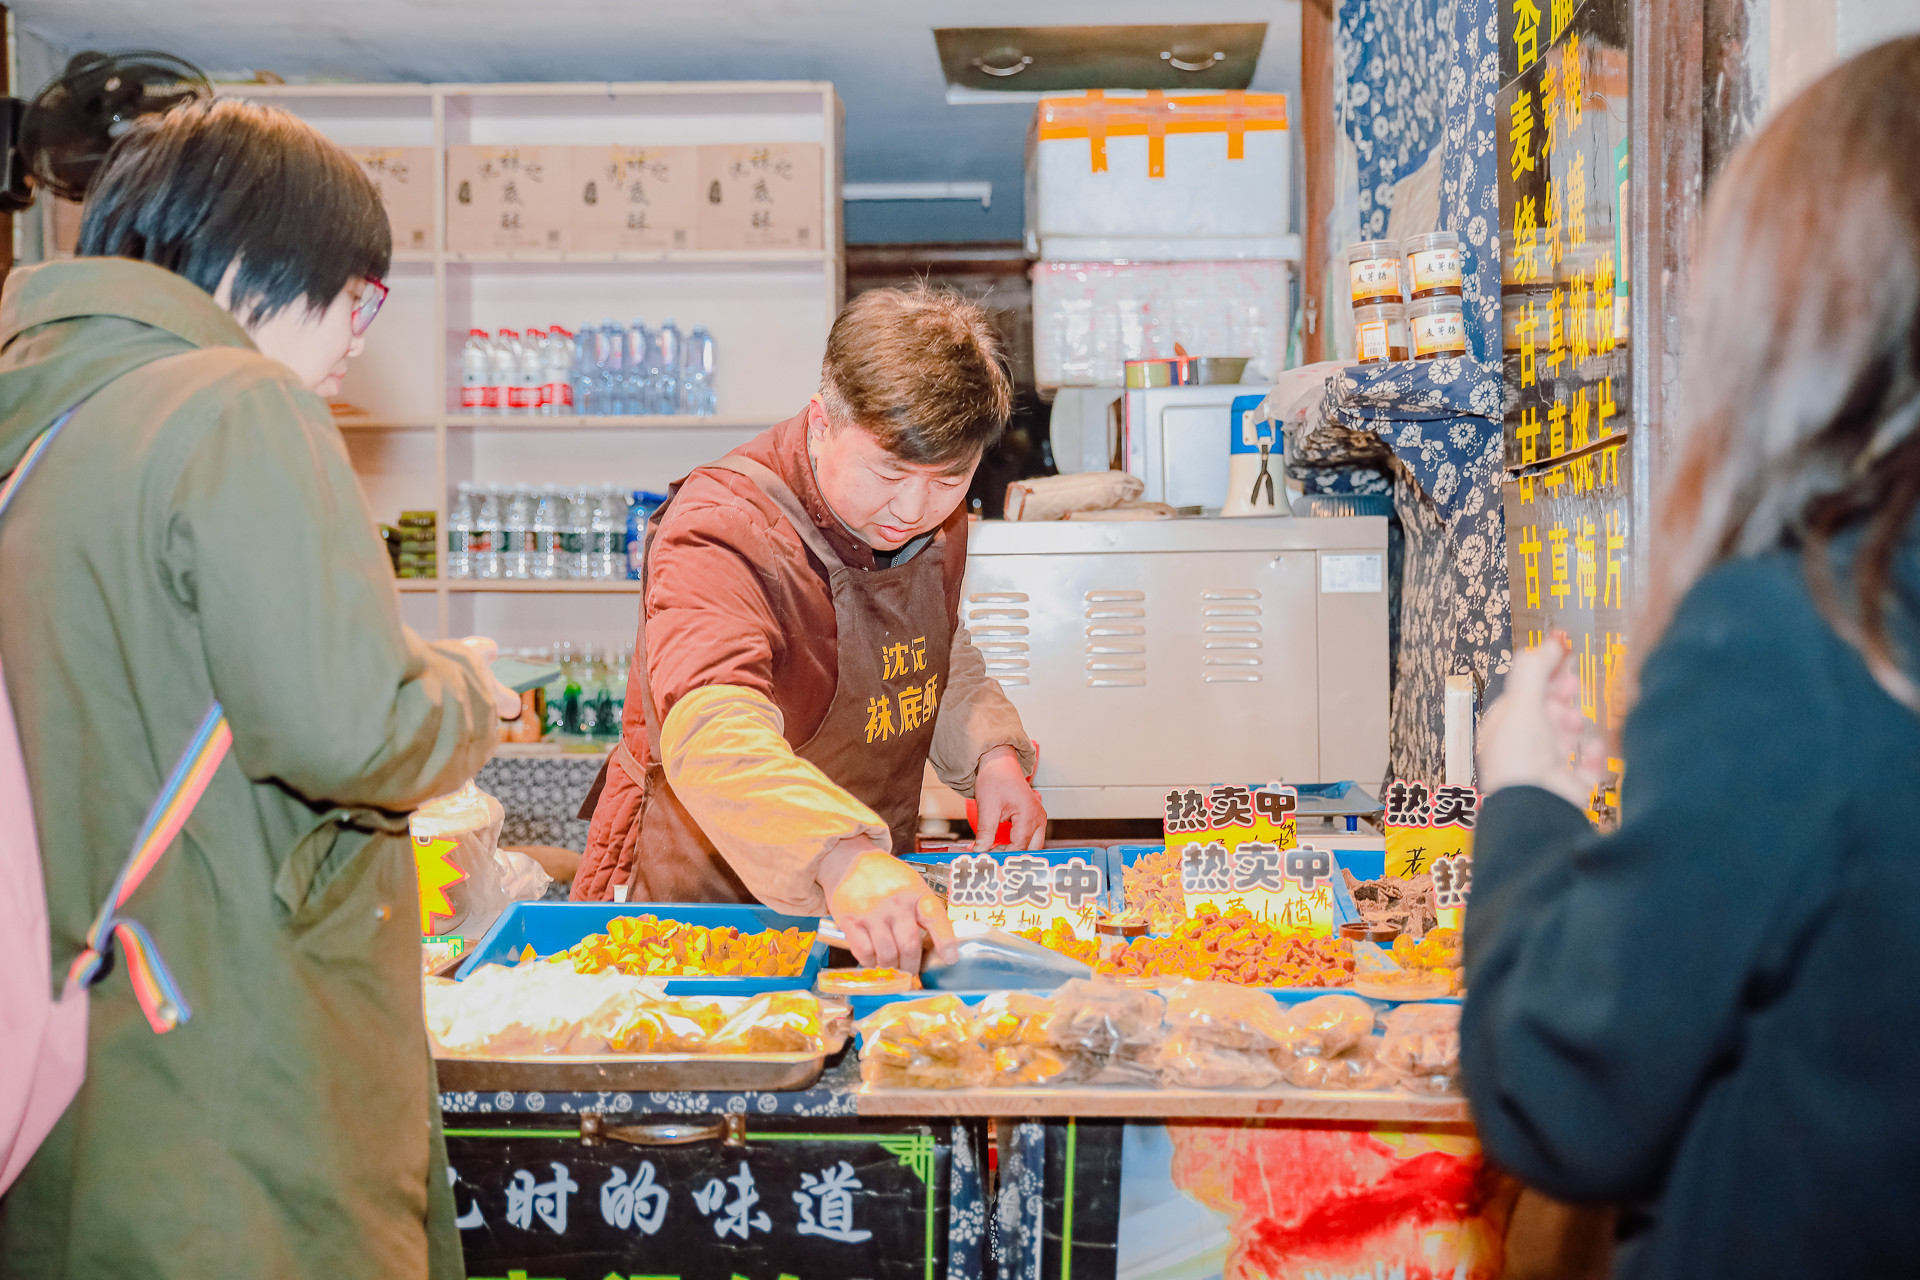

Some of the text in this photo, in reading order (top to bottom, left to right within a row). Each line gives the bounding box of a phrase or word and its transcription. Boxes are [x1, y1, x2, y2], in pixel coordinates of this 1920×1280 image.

[1509, 30, 1583, 182] 麦芽糖
[1512, 150, 1587, 285] 绕绕糖
[1514, 250, 1616, 390] 甘草橄榄
[1515, 375, 1617, 505] 甘草桃片
[1518, 508, 1626, 610] 甘草梅片
[881, 635, 928, 681] 沈记
[863, 672, 939, 744] 袜底酥
[1165, 781, 1297, 833] 热卖中
[951, 855, 1101, 909] 热卖中
[1183, 842, 1332, 892] 热卖中
